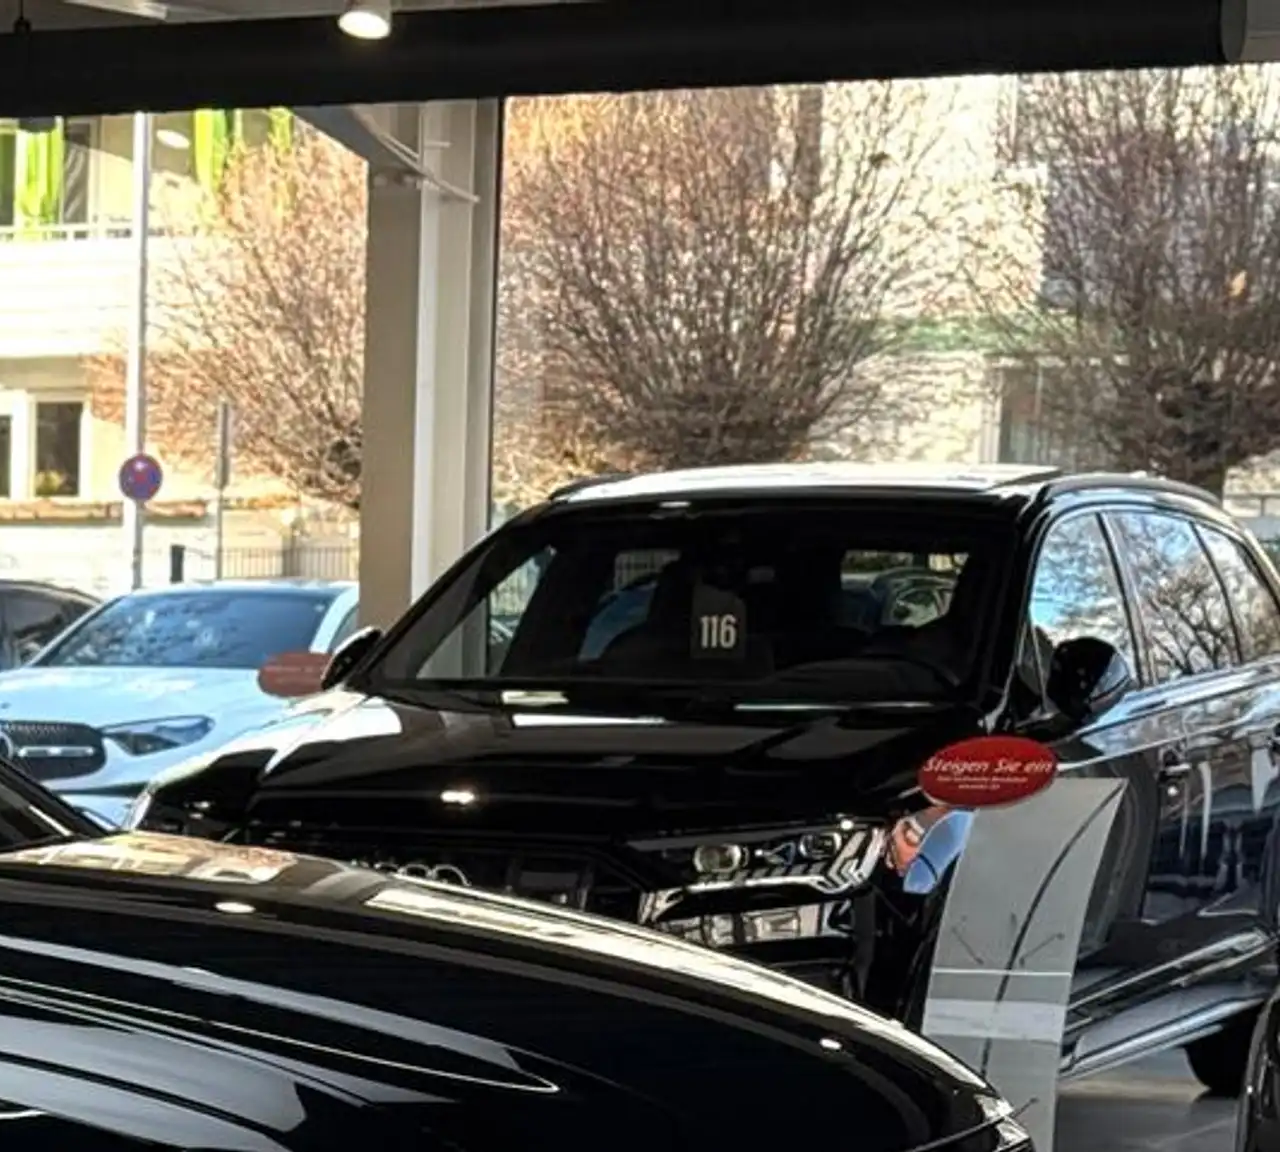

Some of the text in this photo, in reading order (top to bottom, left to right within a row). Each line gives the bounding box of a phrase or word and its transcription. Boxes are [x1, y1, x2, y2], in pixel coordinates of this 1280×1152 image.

[700, 613, 737, 650] 116
[924, 757, 1053, 774] Steigen Sie ein
